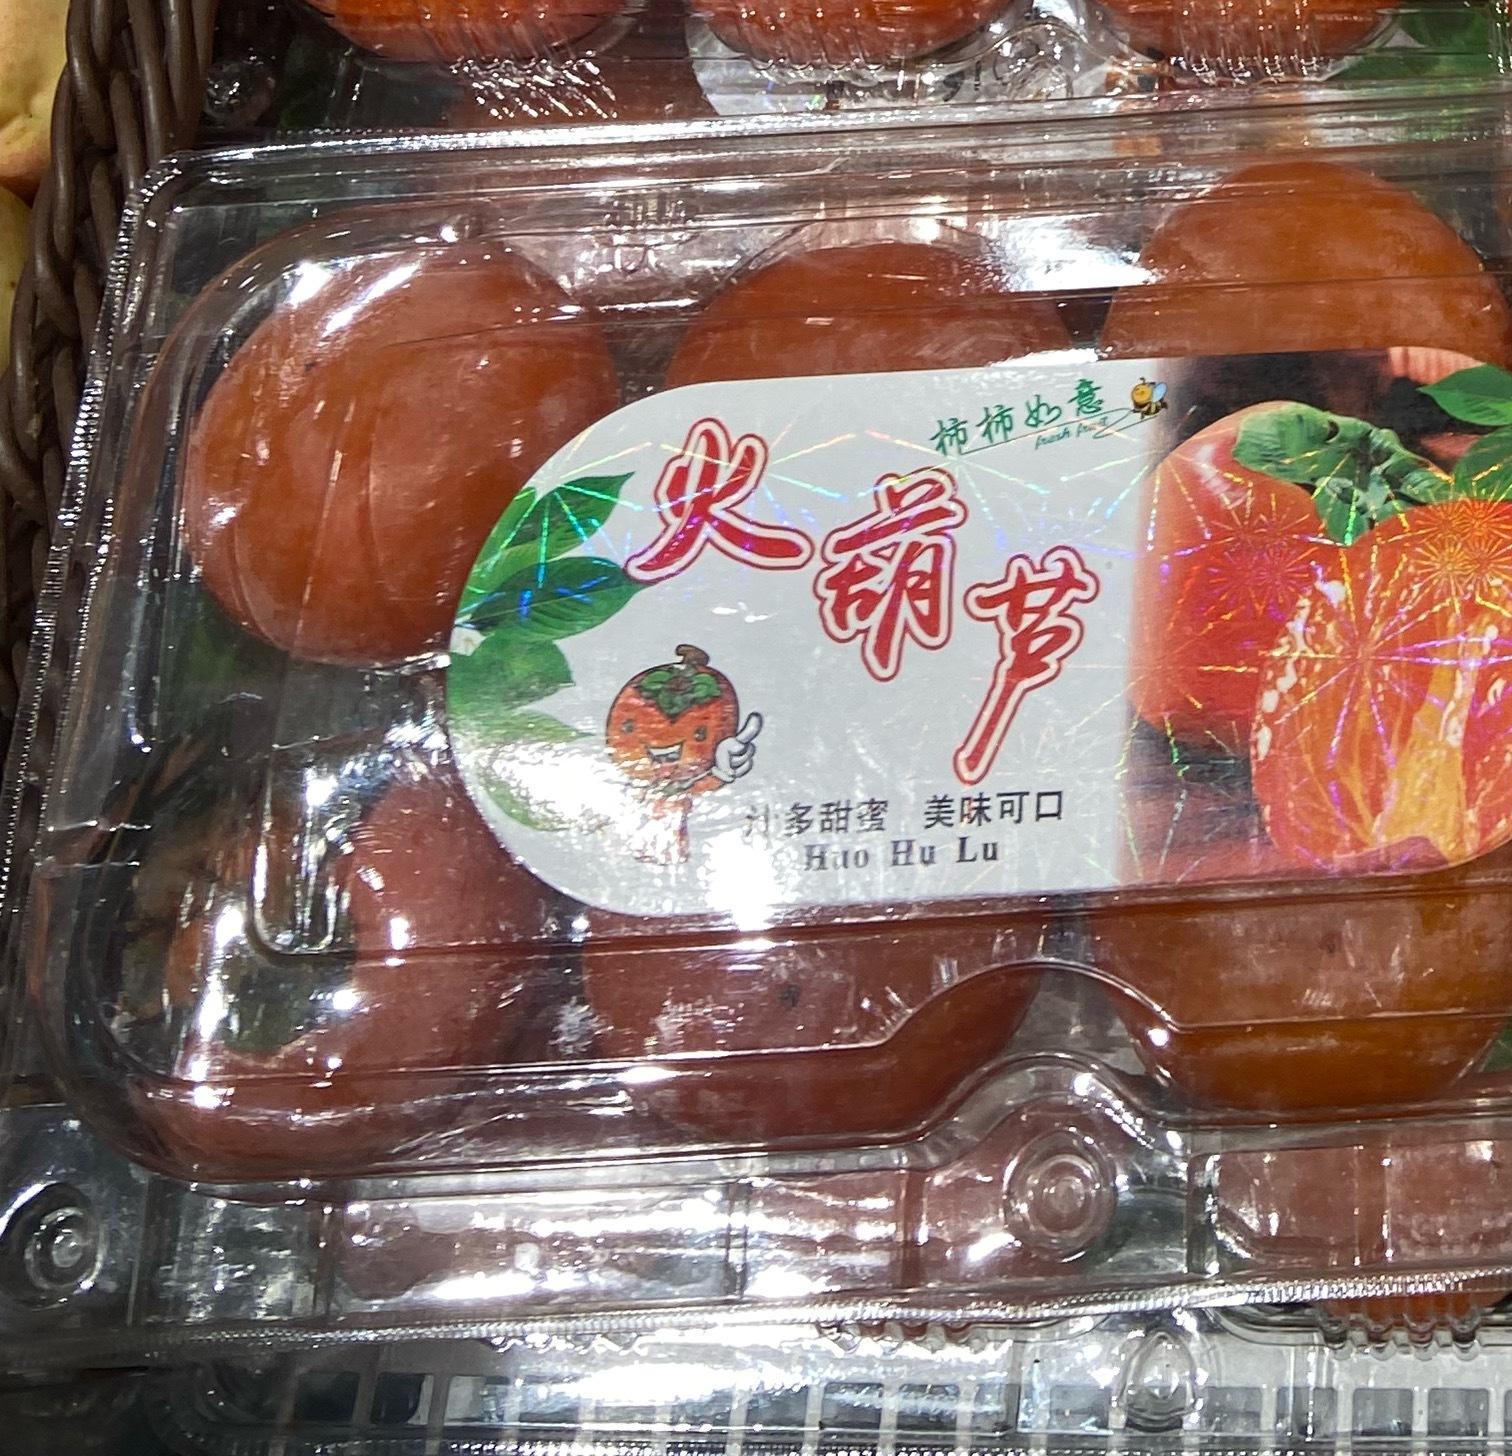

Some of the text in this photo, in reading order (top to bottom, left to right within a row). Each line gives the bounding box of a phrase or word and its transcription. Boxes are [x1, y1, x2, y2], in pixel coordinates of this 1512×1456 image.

[930, 378, 1104, 457] 柿柿如意
[627, 416, 1101, 787] 火葫芦
[924, 790, 1065, 830] 美味可口
[890, 838, 936, 868] Hu
[955, 835, 999, 864] Lu
